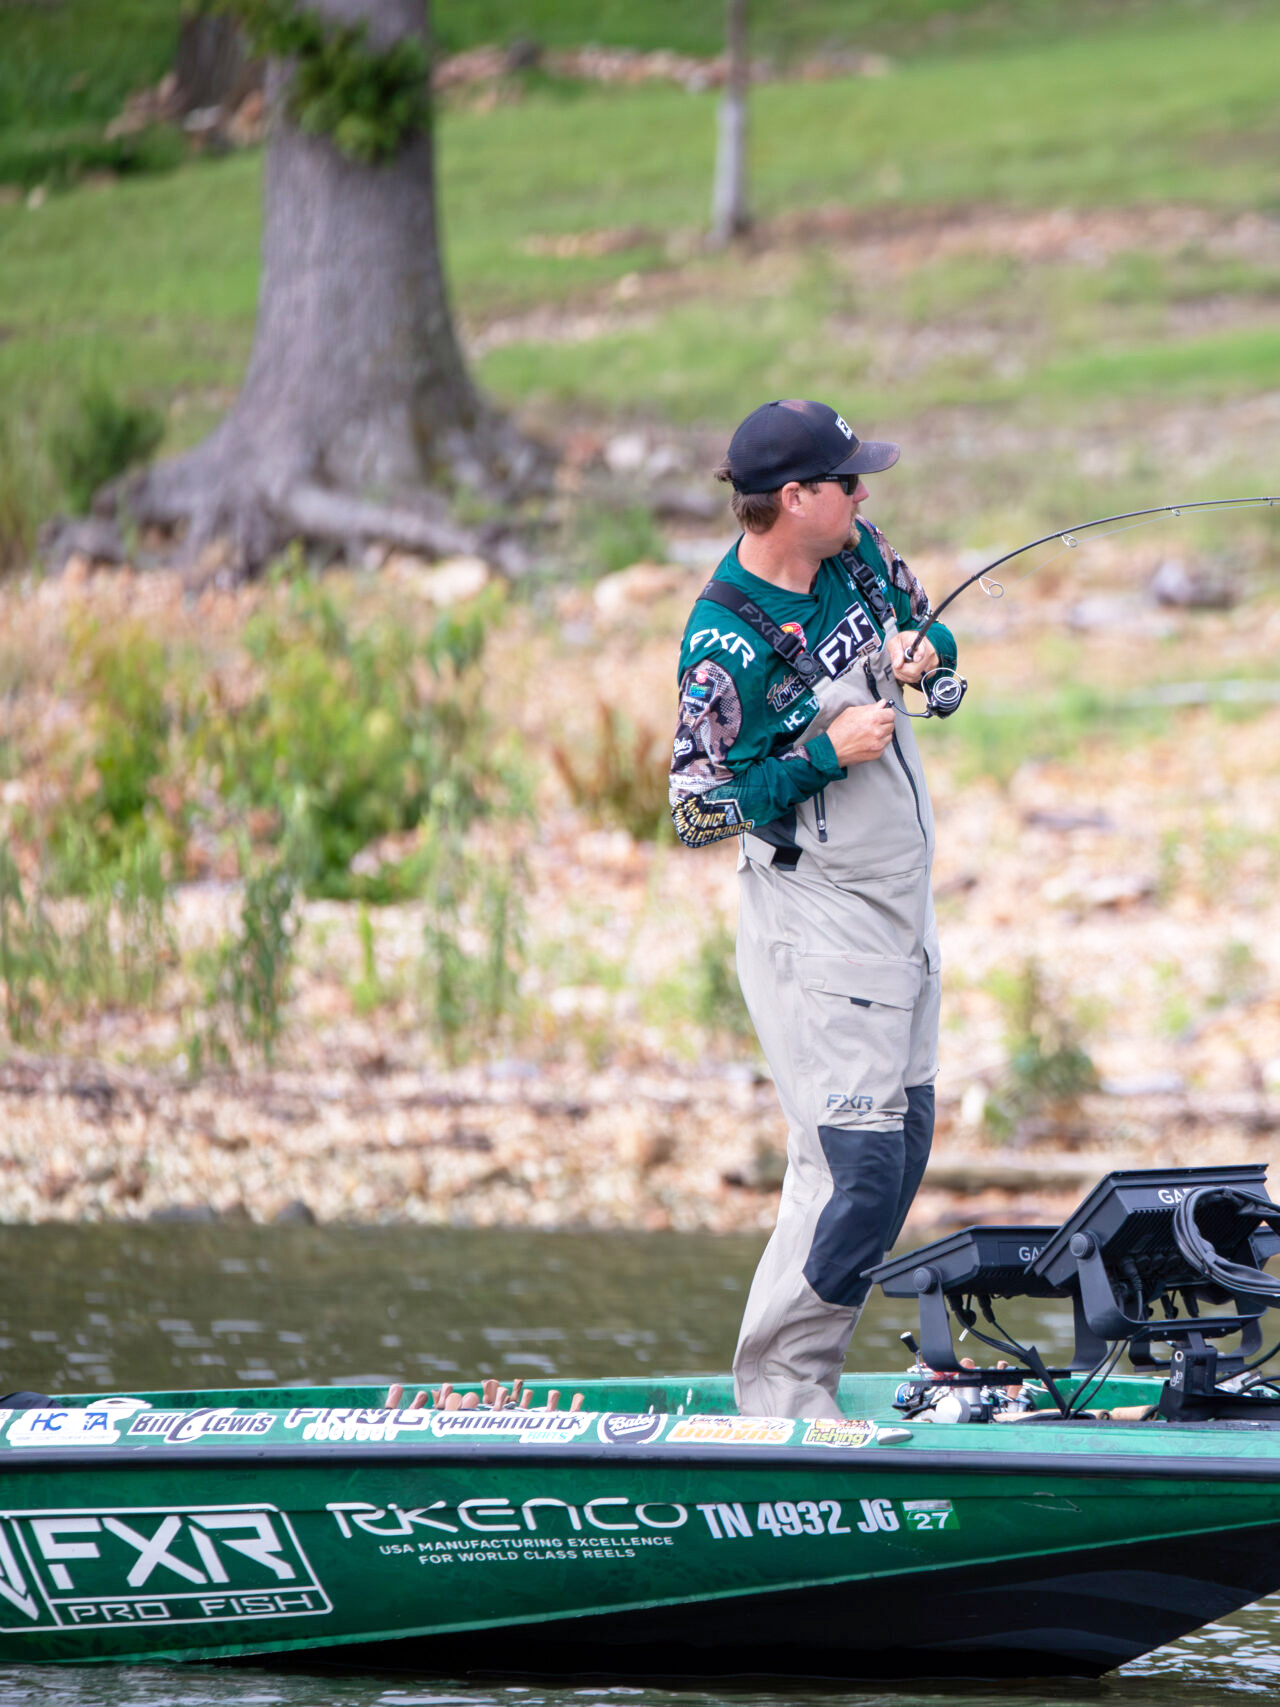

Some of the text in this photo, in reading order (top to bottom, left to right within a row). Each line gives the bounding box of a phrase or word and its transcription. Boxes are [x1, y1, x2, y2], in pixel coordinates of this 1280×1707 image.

[690, 628, 755, 669] FXR
[826, 1093, 873, 1110] FXR
[131, 1414, 273, 1432] Bill Lewis
[438, 1415, 582, 1430] YAMAMOTO
[608, 1413, 657, 1432] Bates
[526, 1430, 569, 1441] BAITS
[807, 1428, 865, 1445] Fishing
[696, 1499, 900, 1539] TN 4932 JG
[913, 1511, 950, 1530] 27
[30, 1512, 297, 1590] FXR
[379, 1536, 675, 1555] USA MANUFACTURING EXCELLENCE
[418, 1548, 636, 1565] FOR WORLD CLASS REELS
[67, 1593, 314, 1623] PRO FISH
